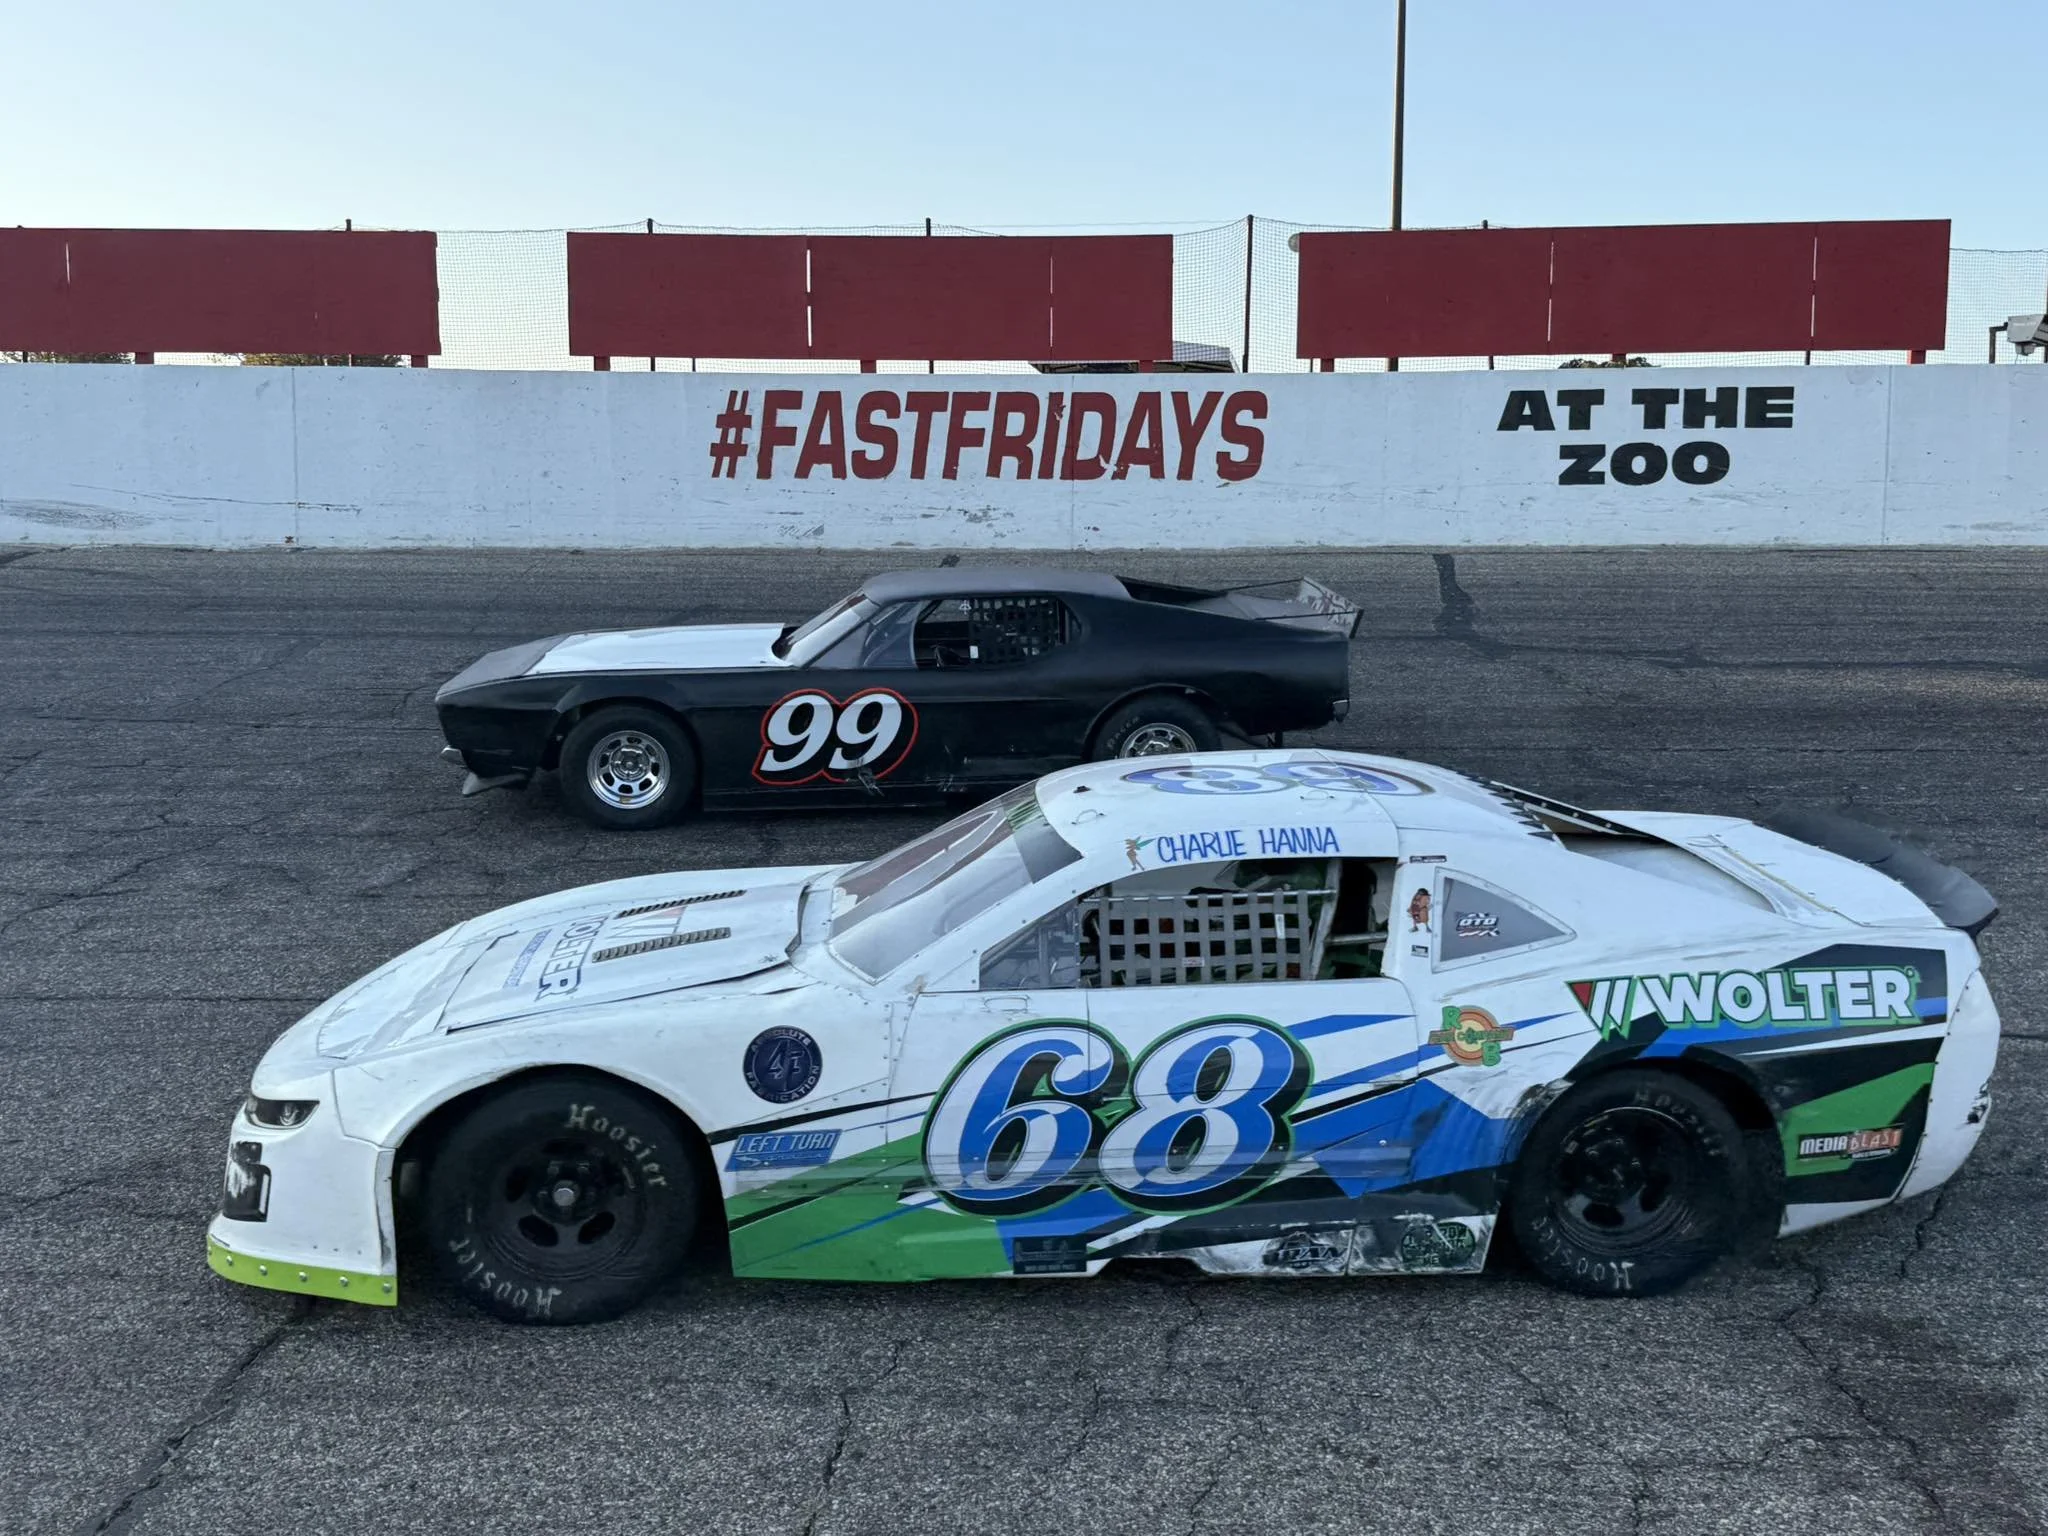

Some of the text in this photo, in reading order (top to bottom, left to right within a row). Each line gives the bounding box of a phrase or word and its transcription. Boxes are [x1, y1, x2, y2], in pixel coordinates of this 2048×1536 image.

[1497, 386, 1795, 431] AT THE
[709, 390, 1268, 480] #FASTFRIDAYS
[1558, 441, 1731, 485] ZOO
[757, 691, 906, 774] 99
[1156, 826, 1341, 863] CHARLIE HANNA
[1641, 968, 1913, 1025] WOLTER
[751, 1029, 812, 1052] AOLUTE
[745, 1064, 821, 1102] FAICATION
[923, 1021, 1300, 1204] 68
[562, 1103, 668, 1188] Hoosier
[735, 1132, 838, 1154] LEFT TURN
[1800, 1135, 1849, 1156] MEDIA
